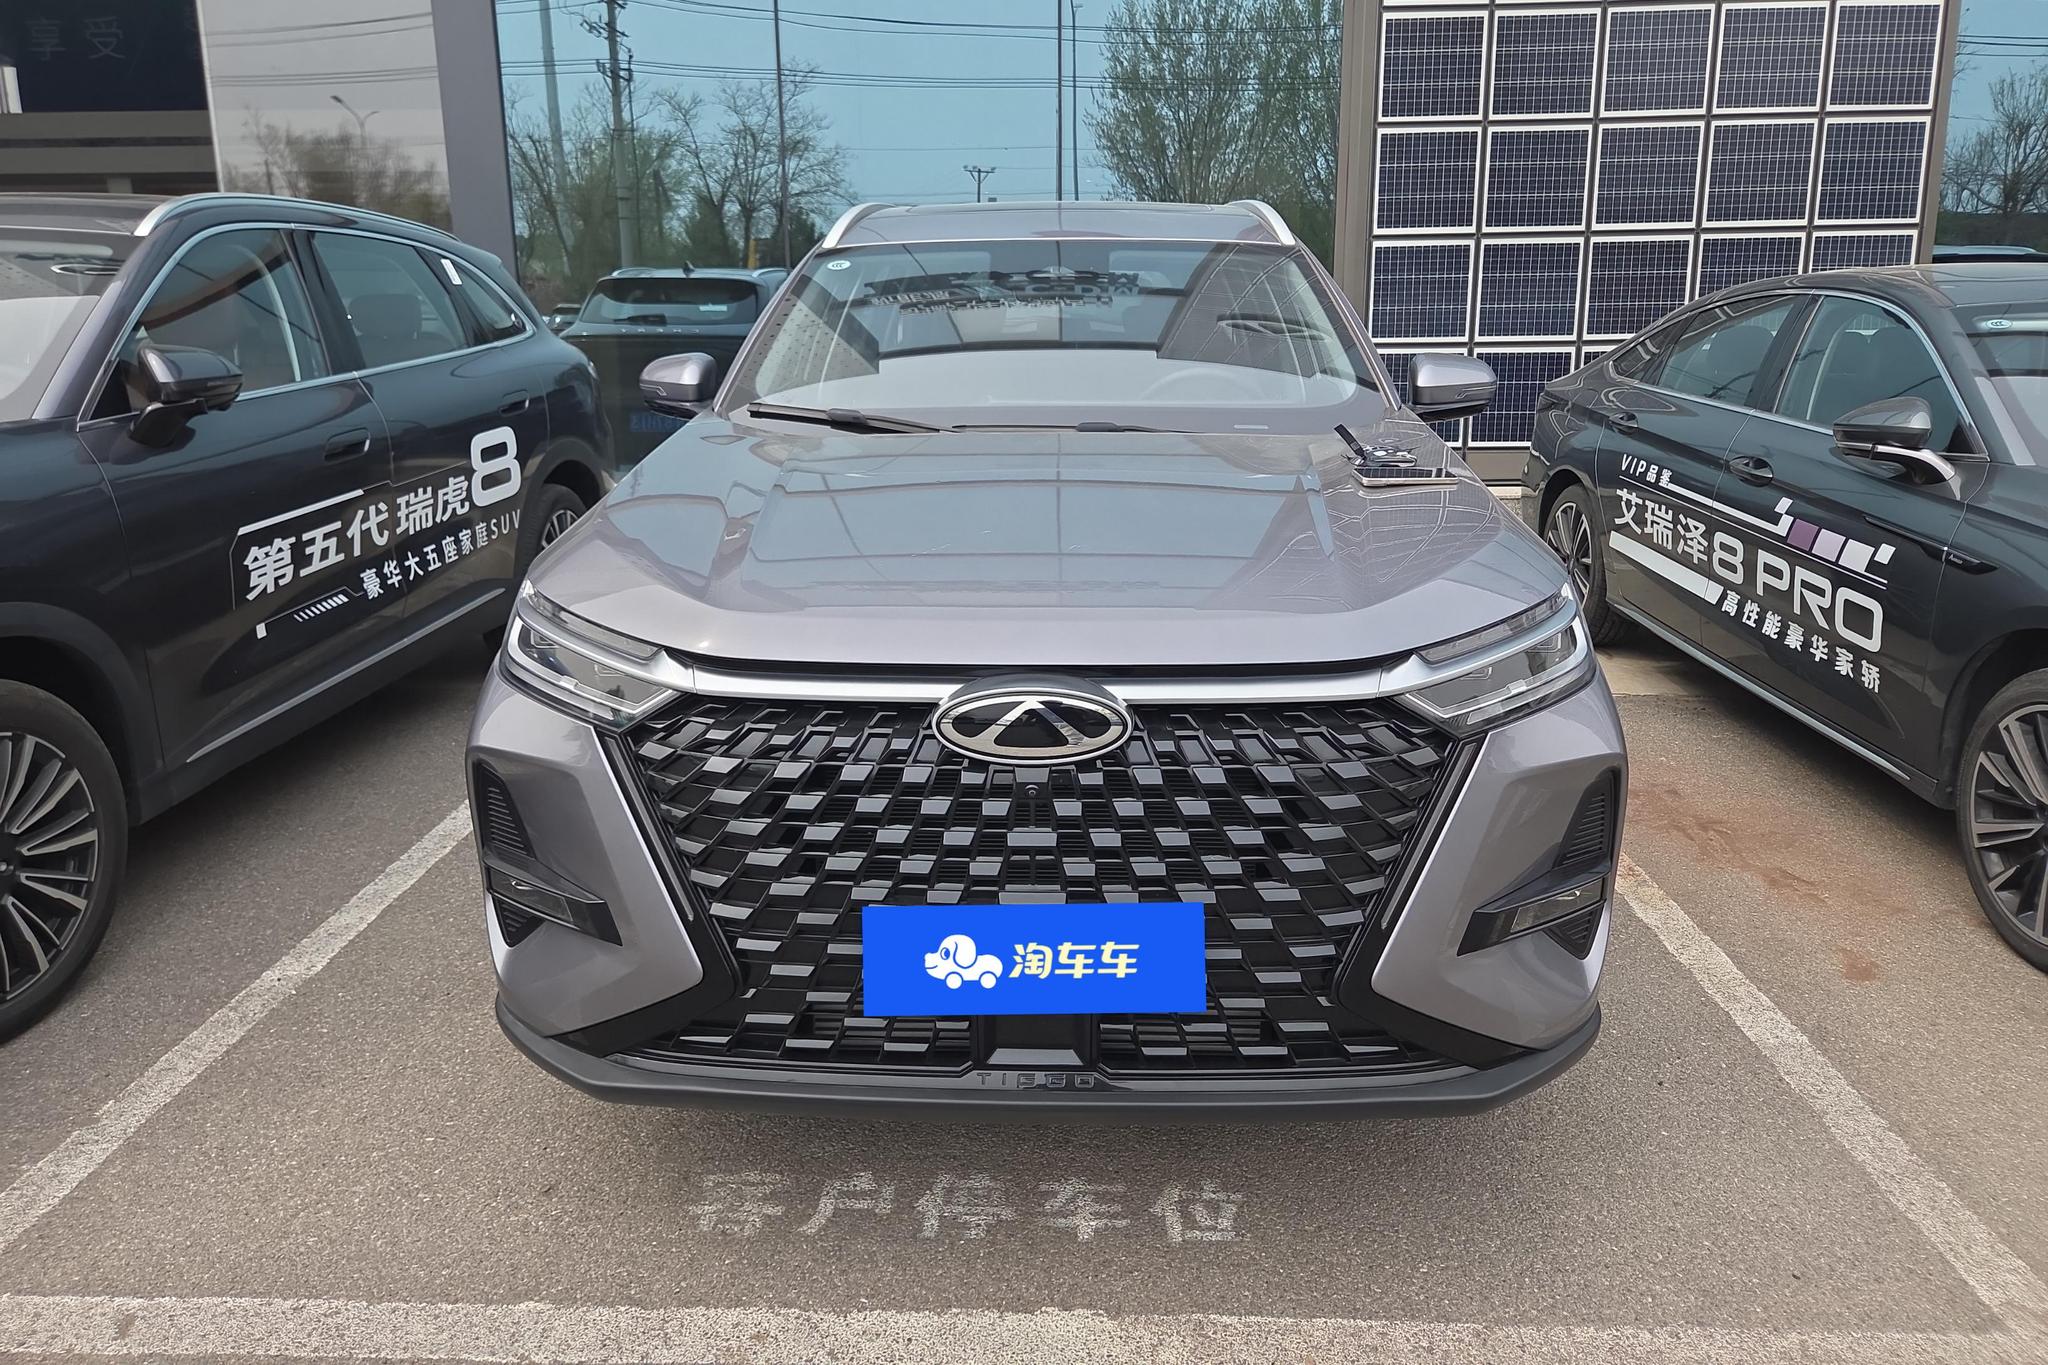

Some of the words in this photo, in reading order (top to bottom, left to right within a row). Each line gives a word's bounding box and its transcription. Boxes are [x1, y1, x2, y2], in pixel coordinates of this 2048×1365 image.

[360, 508, 521, 600] 豪华大五座家庭SUV
[1614, 488, 1744, 585] 艾瑞泽8
[1756, 549, 1884, 653] PRO
[1720, 589, 1881, 693] 高性能豪华家轿
